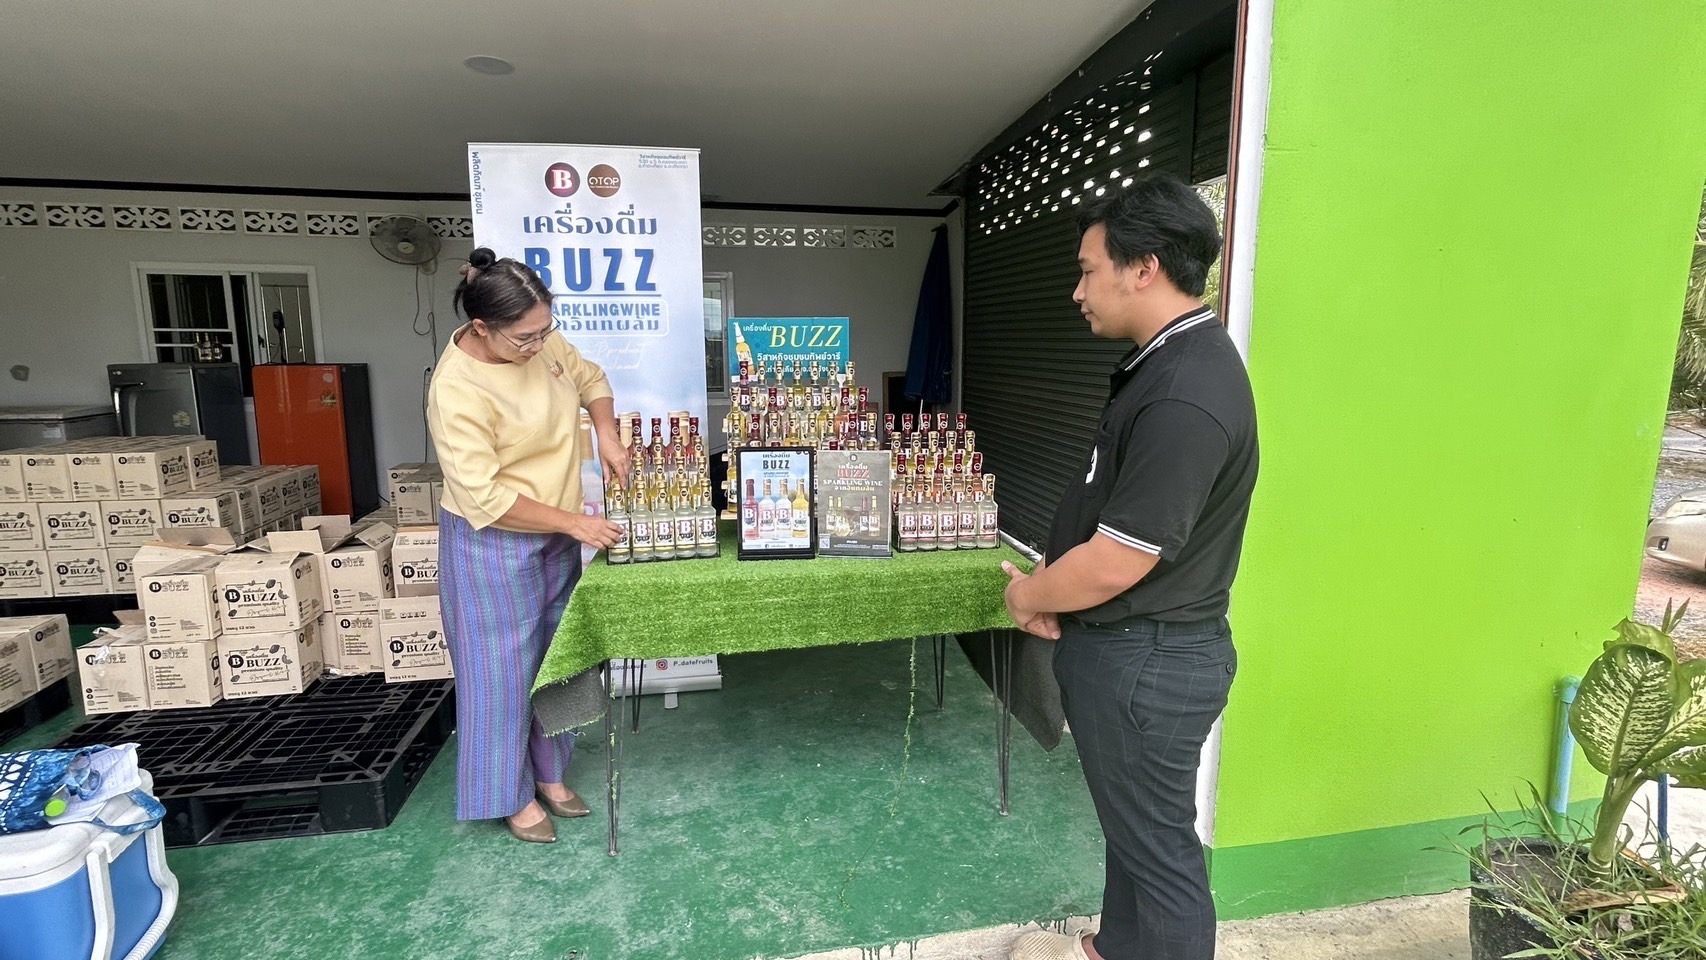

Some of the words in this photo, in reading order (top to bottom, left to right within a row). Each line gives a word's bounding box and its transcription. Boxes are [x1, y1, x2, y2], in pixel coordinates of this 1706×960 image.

[552, 169, 573, 189] B
[588, 176, 619, 185] OTOP
[523, 202, 658, 235] เครื่องดื่ม
[524, 247, 657, 292] BUZZ
[552, 303, 660, 317] ARKLINGWINE
[769, 325, 842, 348] BUZZ
[757, 352, 841, 362] วิสาหกิจชุมชนทิพย์วารี
[741, 394, 750, 406] B
[776, 396, 784, 406] B
[813, 395, 821, 406] B
[762, 460, 790, 470] BUZZ
[905, 515, 914, 526] B
[922, 514, 932, 526] B
[944, 514, 953, 526] B
[962, 514, 972, 525] B
[986, 514, 994, 525] B
[636, 523, 648, 536] B
[659, 522, 670, 535] B
[680, 521, 690, 534] B
[703, 520, 712, 532] B
[416, 570, 438, 578] BUZ
[229, 592, 238, 600] B
[243, 592, 277, 602] BUZZ
[406, 643, 438, 653] BUZZ
[232, 657, 240, 666] B
[246, 658, 280, 667] BUZZ
